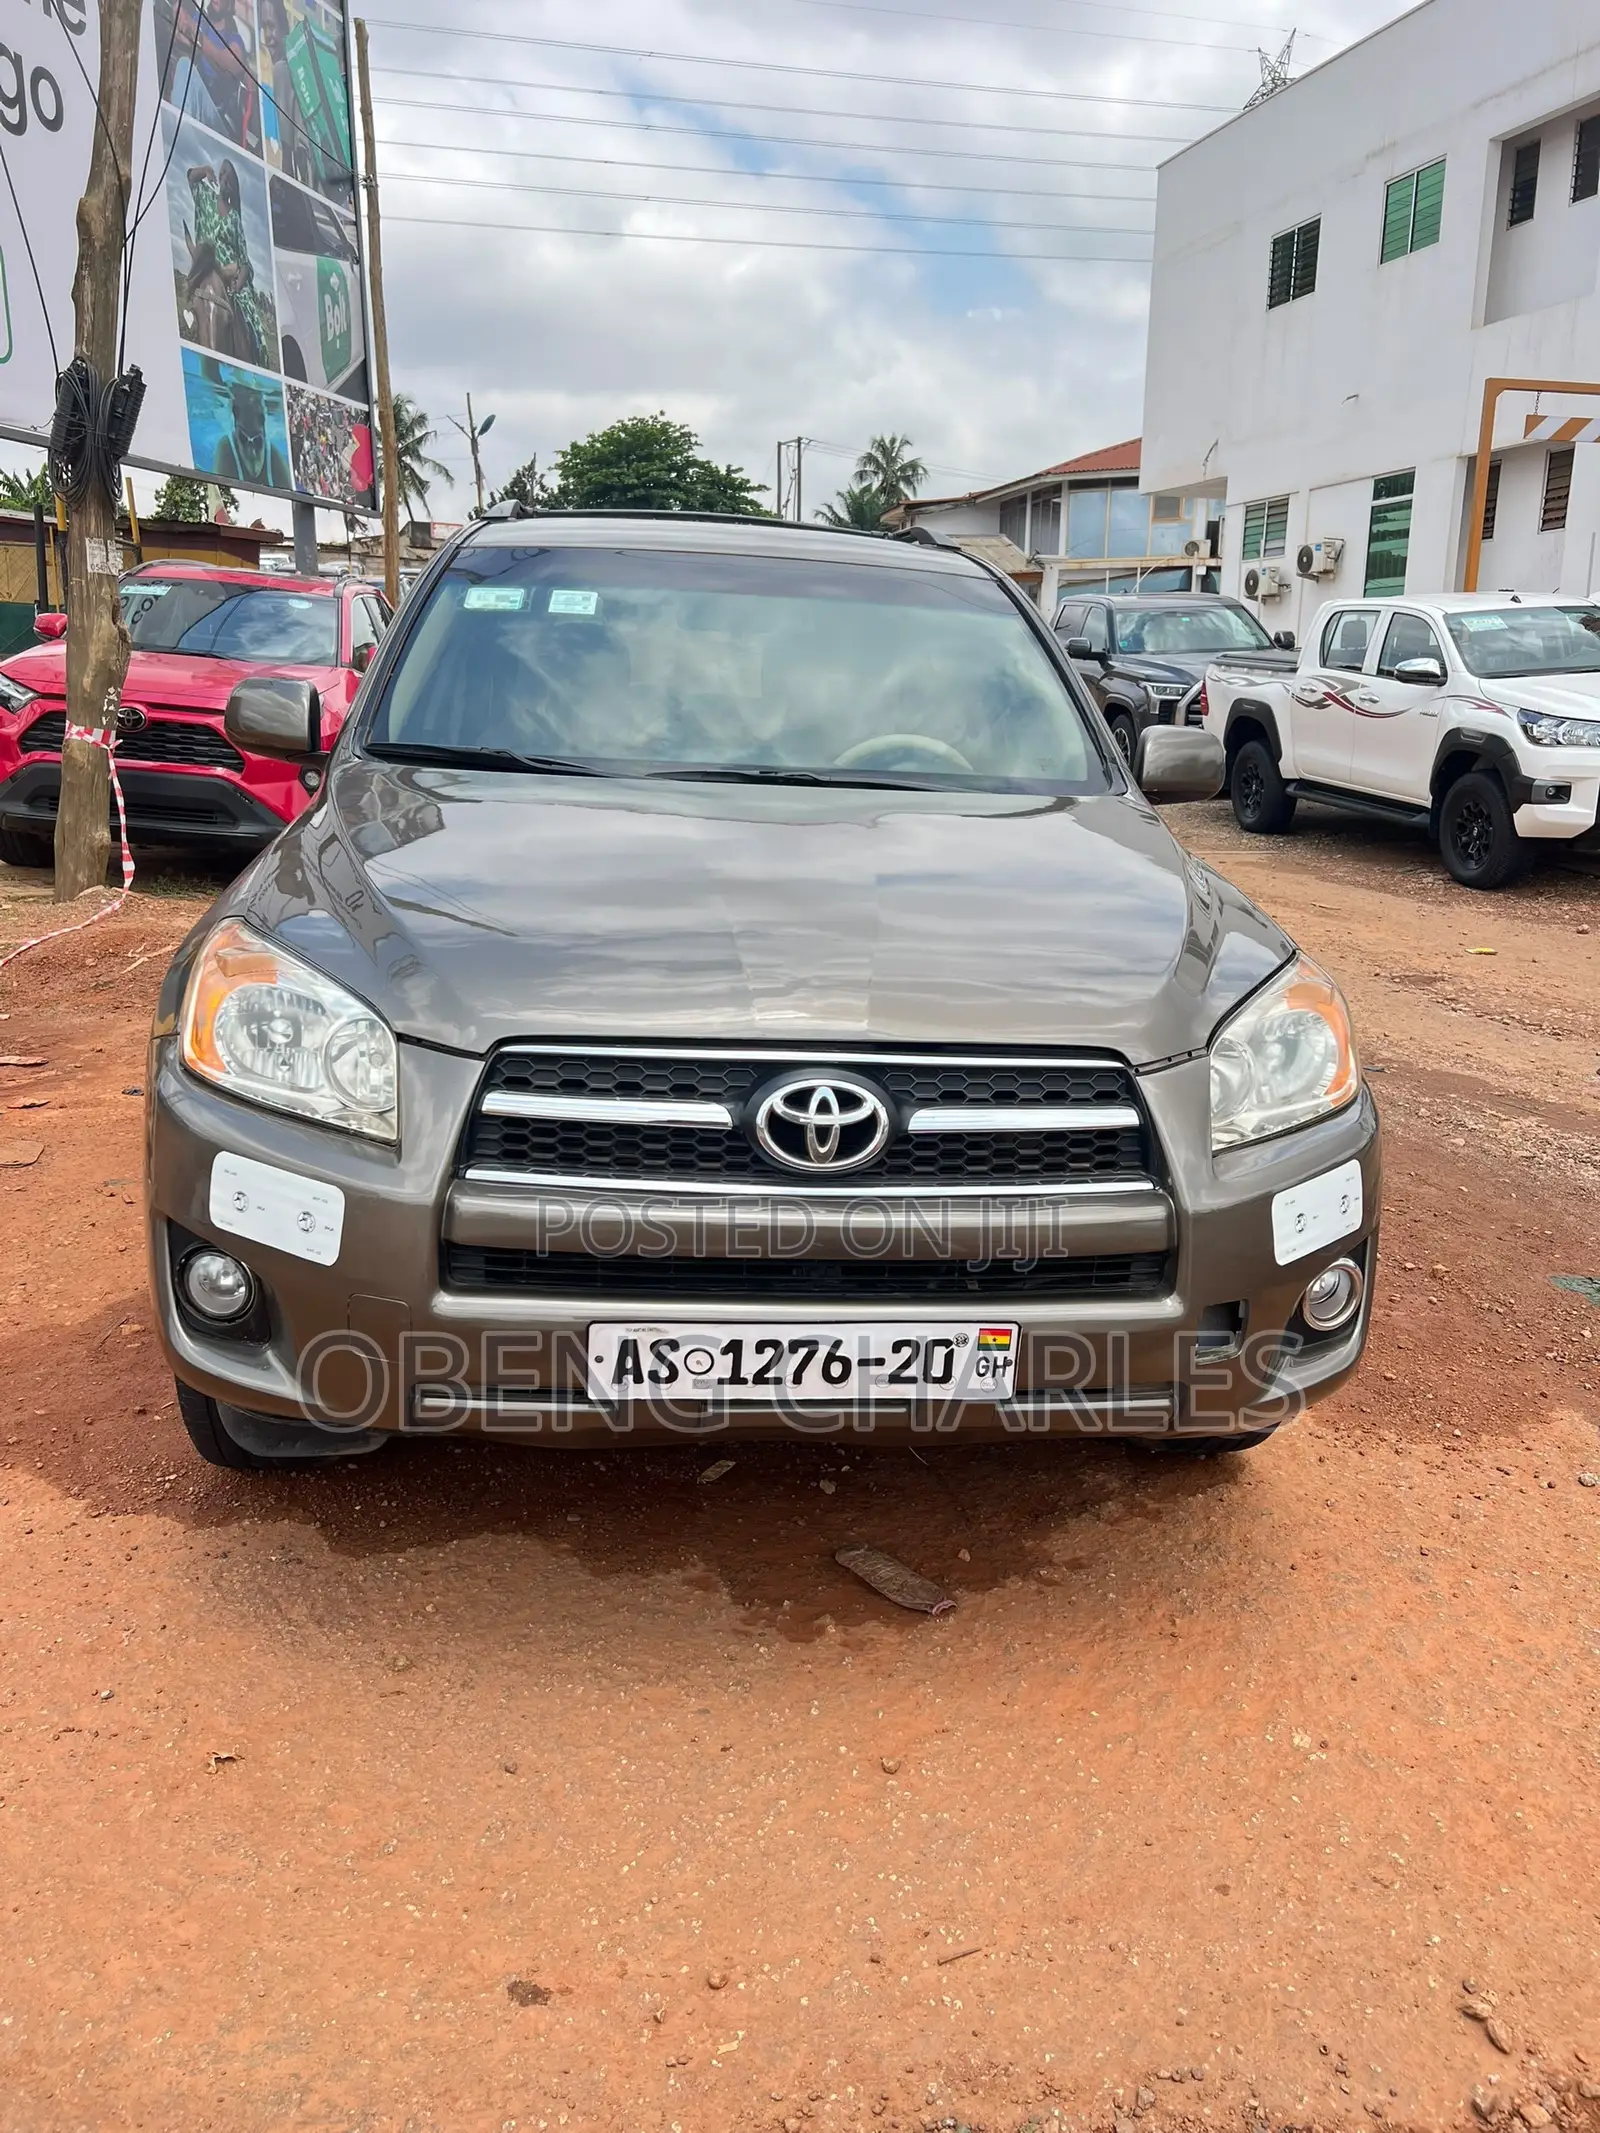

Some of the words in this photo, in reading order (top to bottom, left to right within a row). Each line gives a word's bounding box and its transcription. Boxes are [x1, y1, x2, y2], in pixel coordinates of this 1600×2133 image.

[324, 290, 347, 341] Bolt
[611, 1338, 681, 1385] AS
[975, 1355, 1013, 1378] GH
